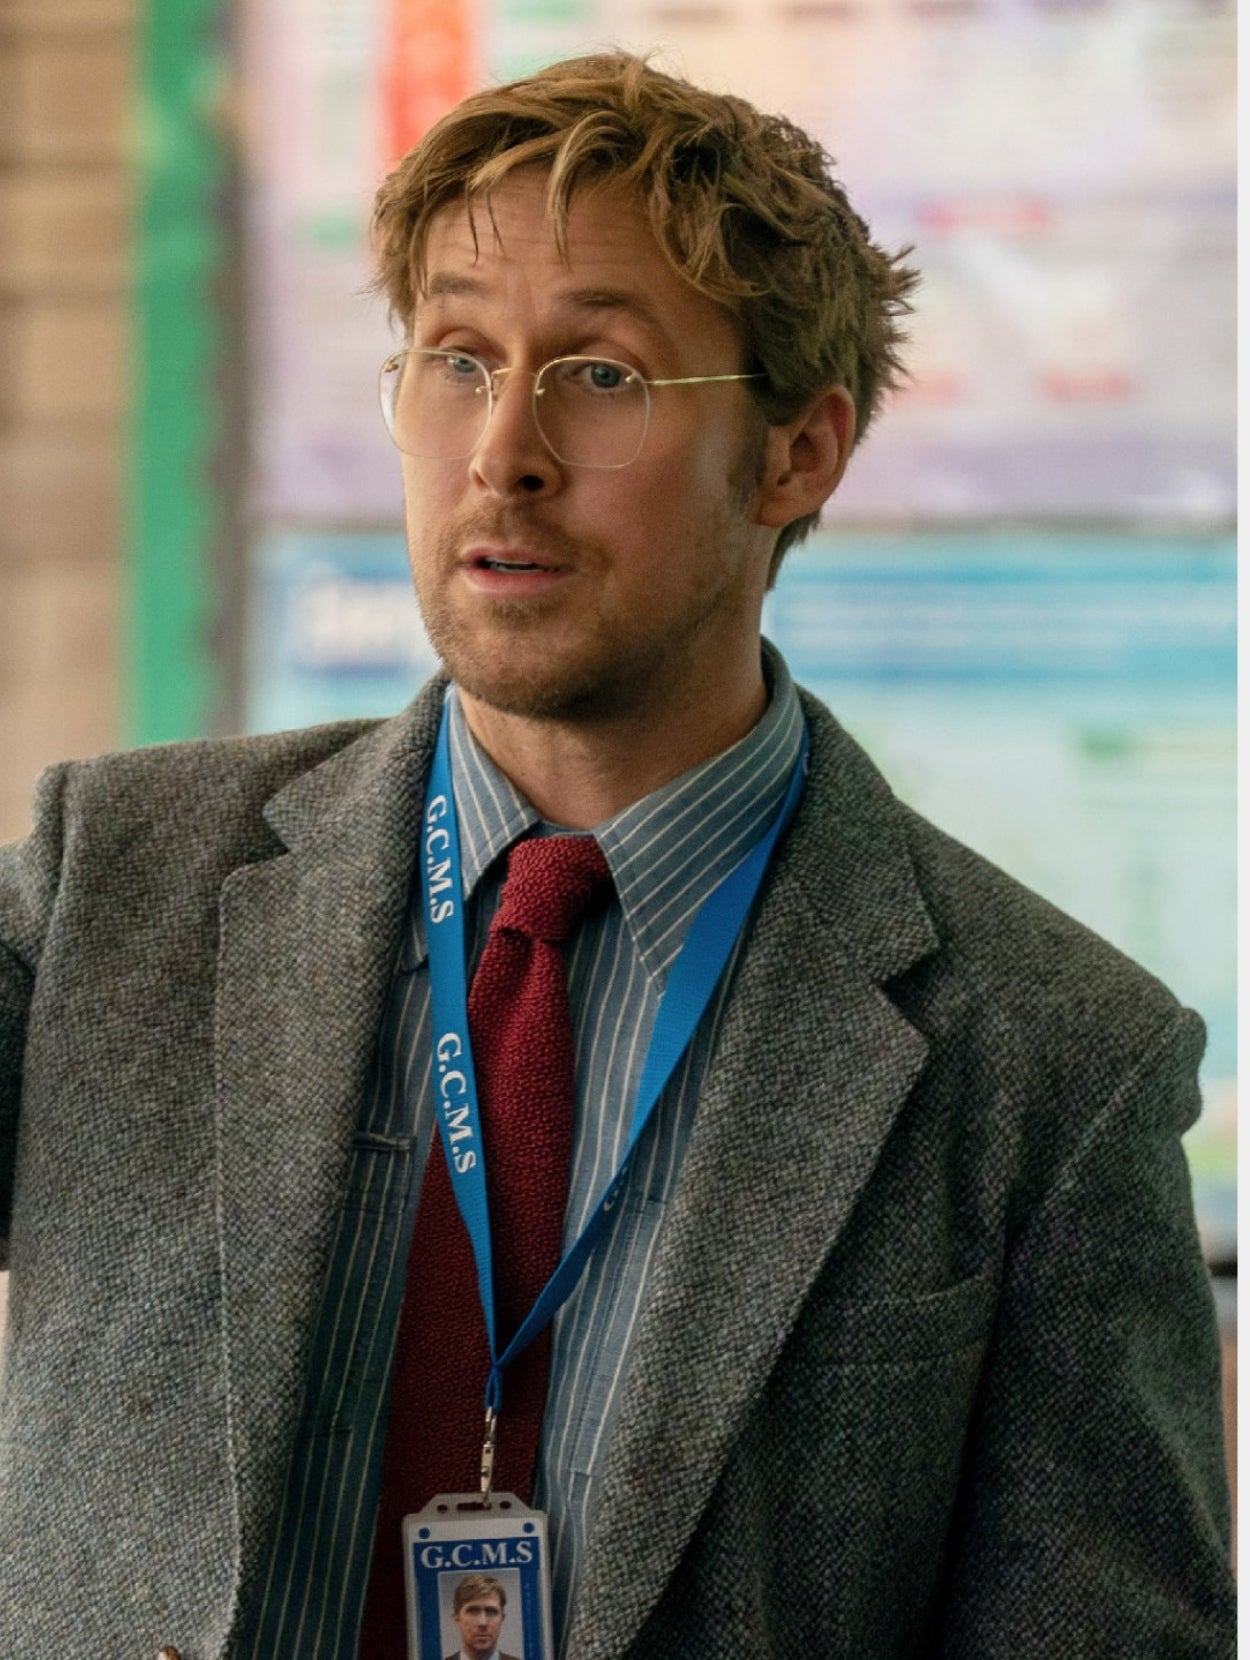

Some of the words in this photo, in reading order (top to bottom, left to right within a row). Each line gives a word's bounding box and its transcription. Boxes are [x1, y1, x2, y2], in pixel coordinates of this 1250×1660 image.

[426, 795, 454, 924] G.C.M.S
[437, 1033, 476, 1173] G.C.M.S
[420, 1541, 533, 1569] G.C.M.S
